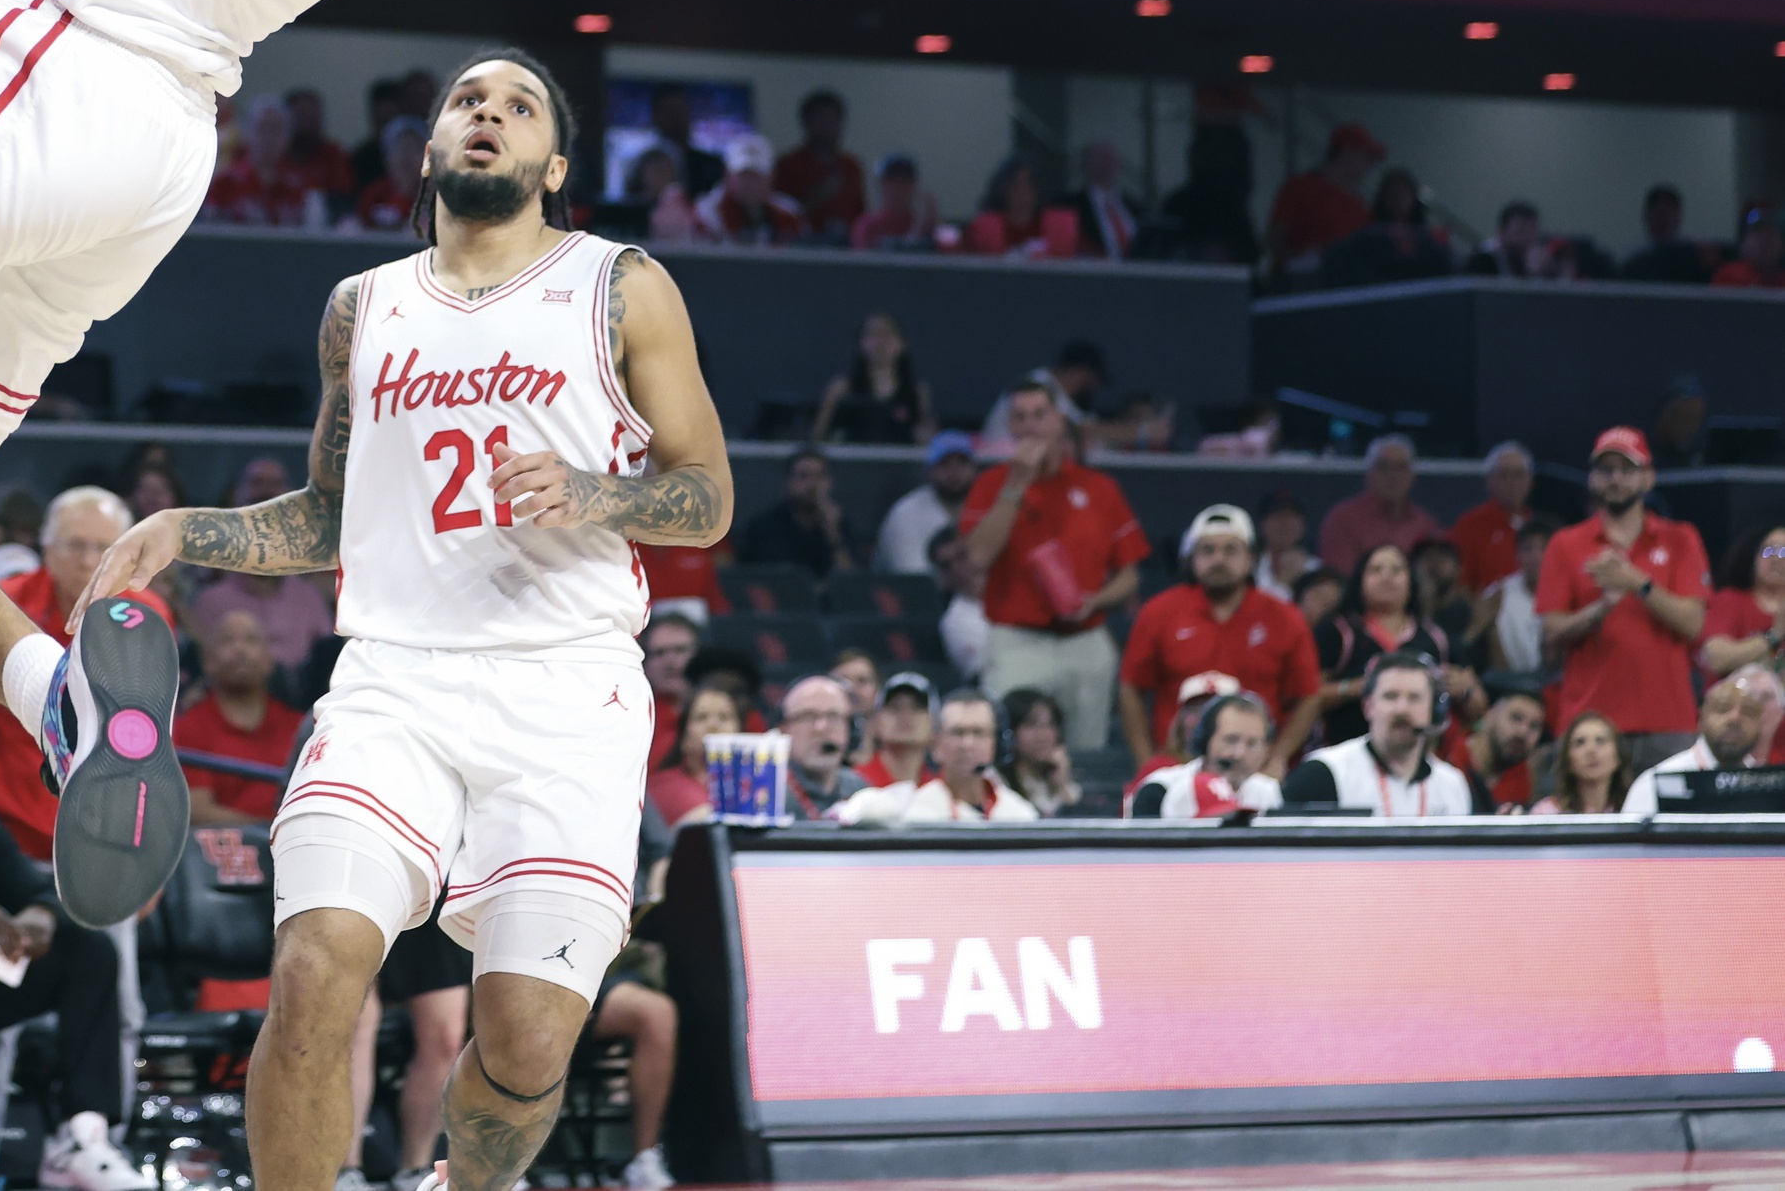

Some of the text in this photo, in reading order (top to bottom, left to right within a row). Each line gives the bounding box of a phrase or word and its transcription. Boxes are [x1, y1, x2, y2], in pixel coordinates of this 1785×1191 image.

[371, 347, 566, 424] Houston
[424, 424, 513, 535] 21
[865, 935, 1105, 1035] FAN
